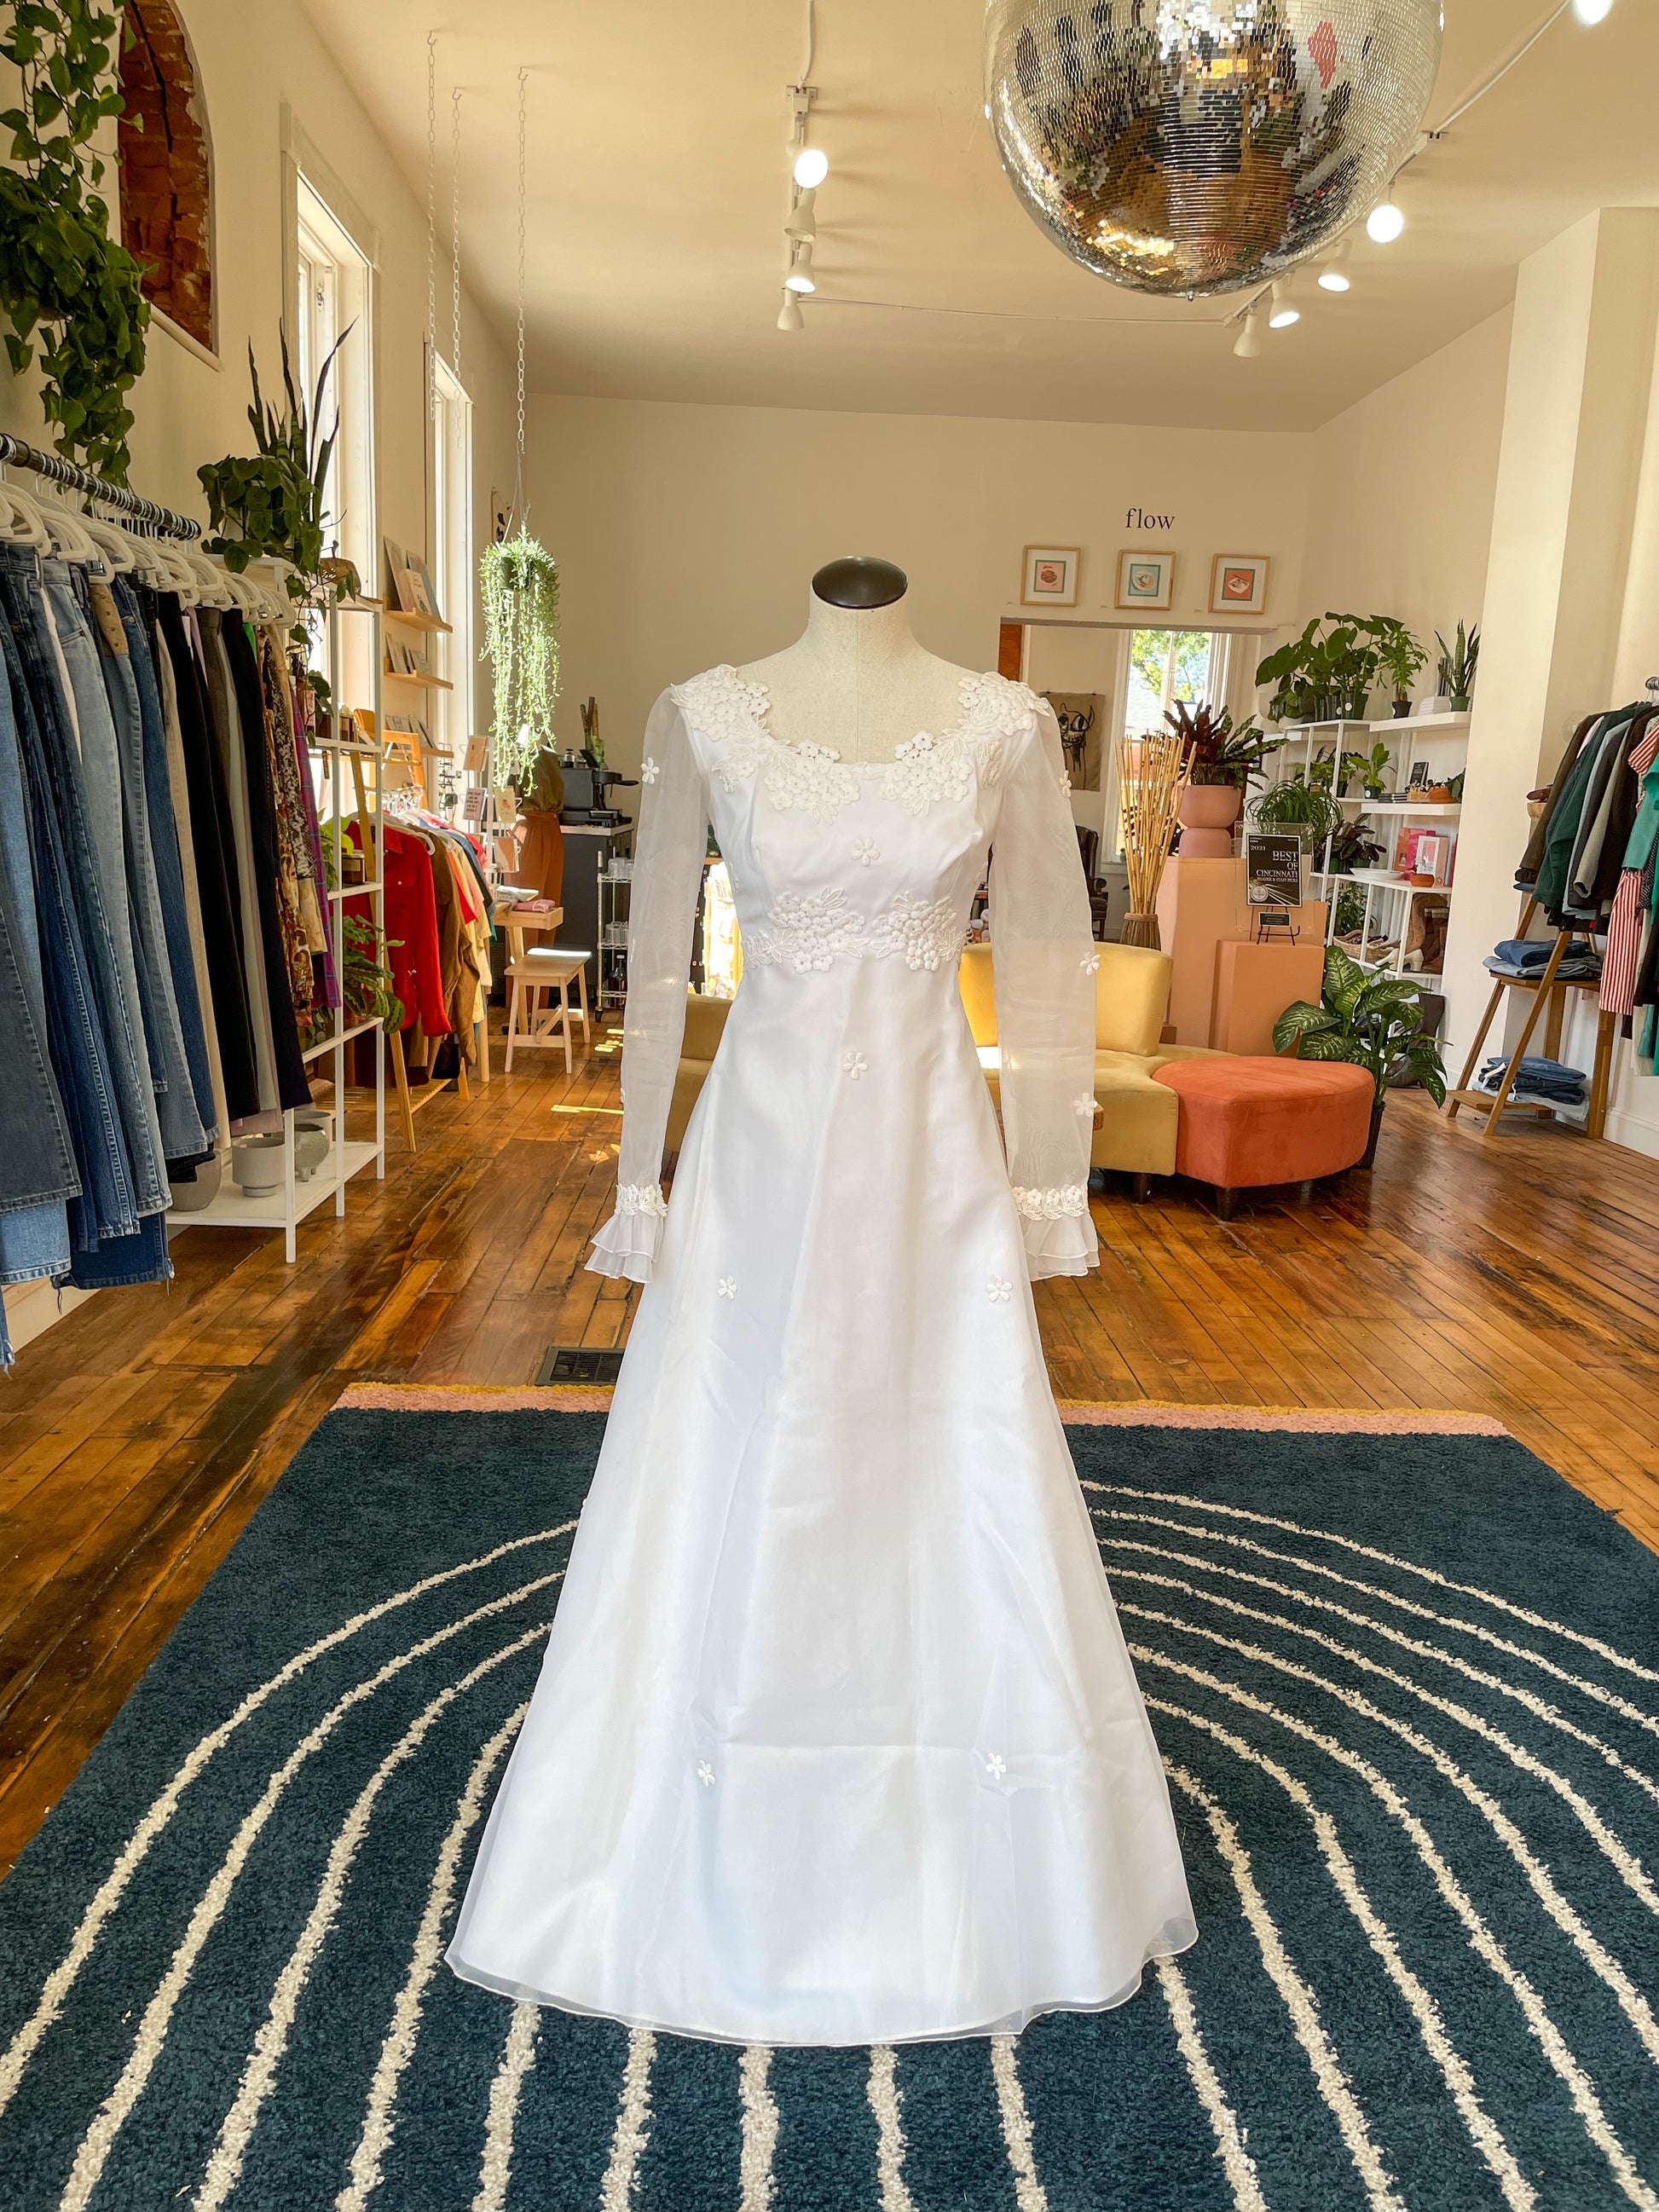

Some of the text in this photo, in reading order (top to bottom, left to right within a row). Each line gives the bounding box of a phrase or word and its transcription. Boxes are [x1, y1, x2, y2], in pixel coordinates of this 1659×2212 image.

[1125, 507, 1176, 529] flow
[1272, 850, 1298, 862] BEST
[1286, 862, 1298, 870] OF
[1256, 869, 1298, 878] CINCINNATI
